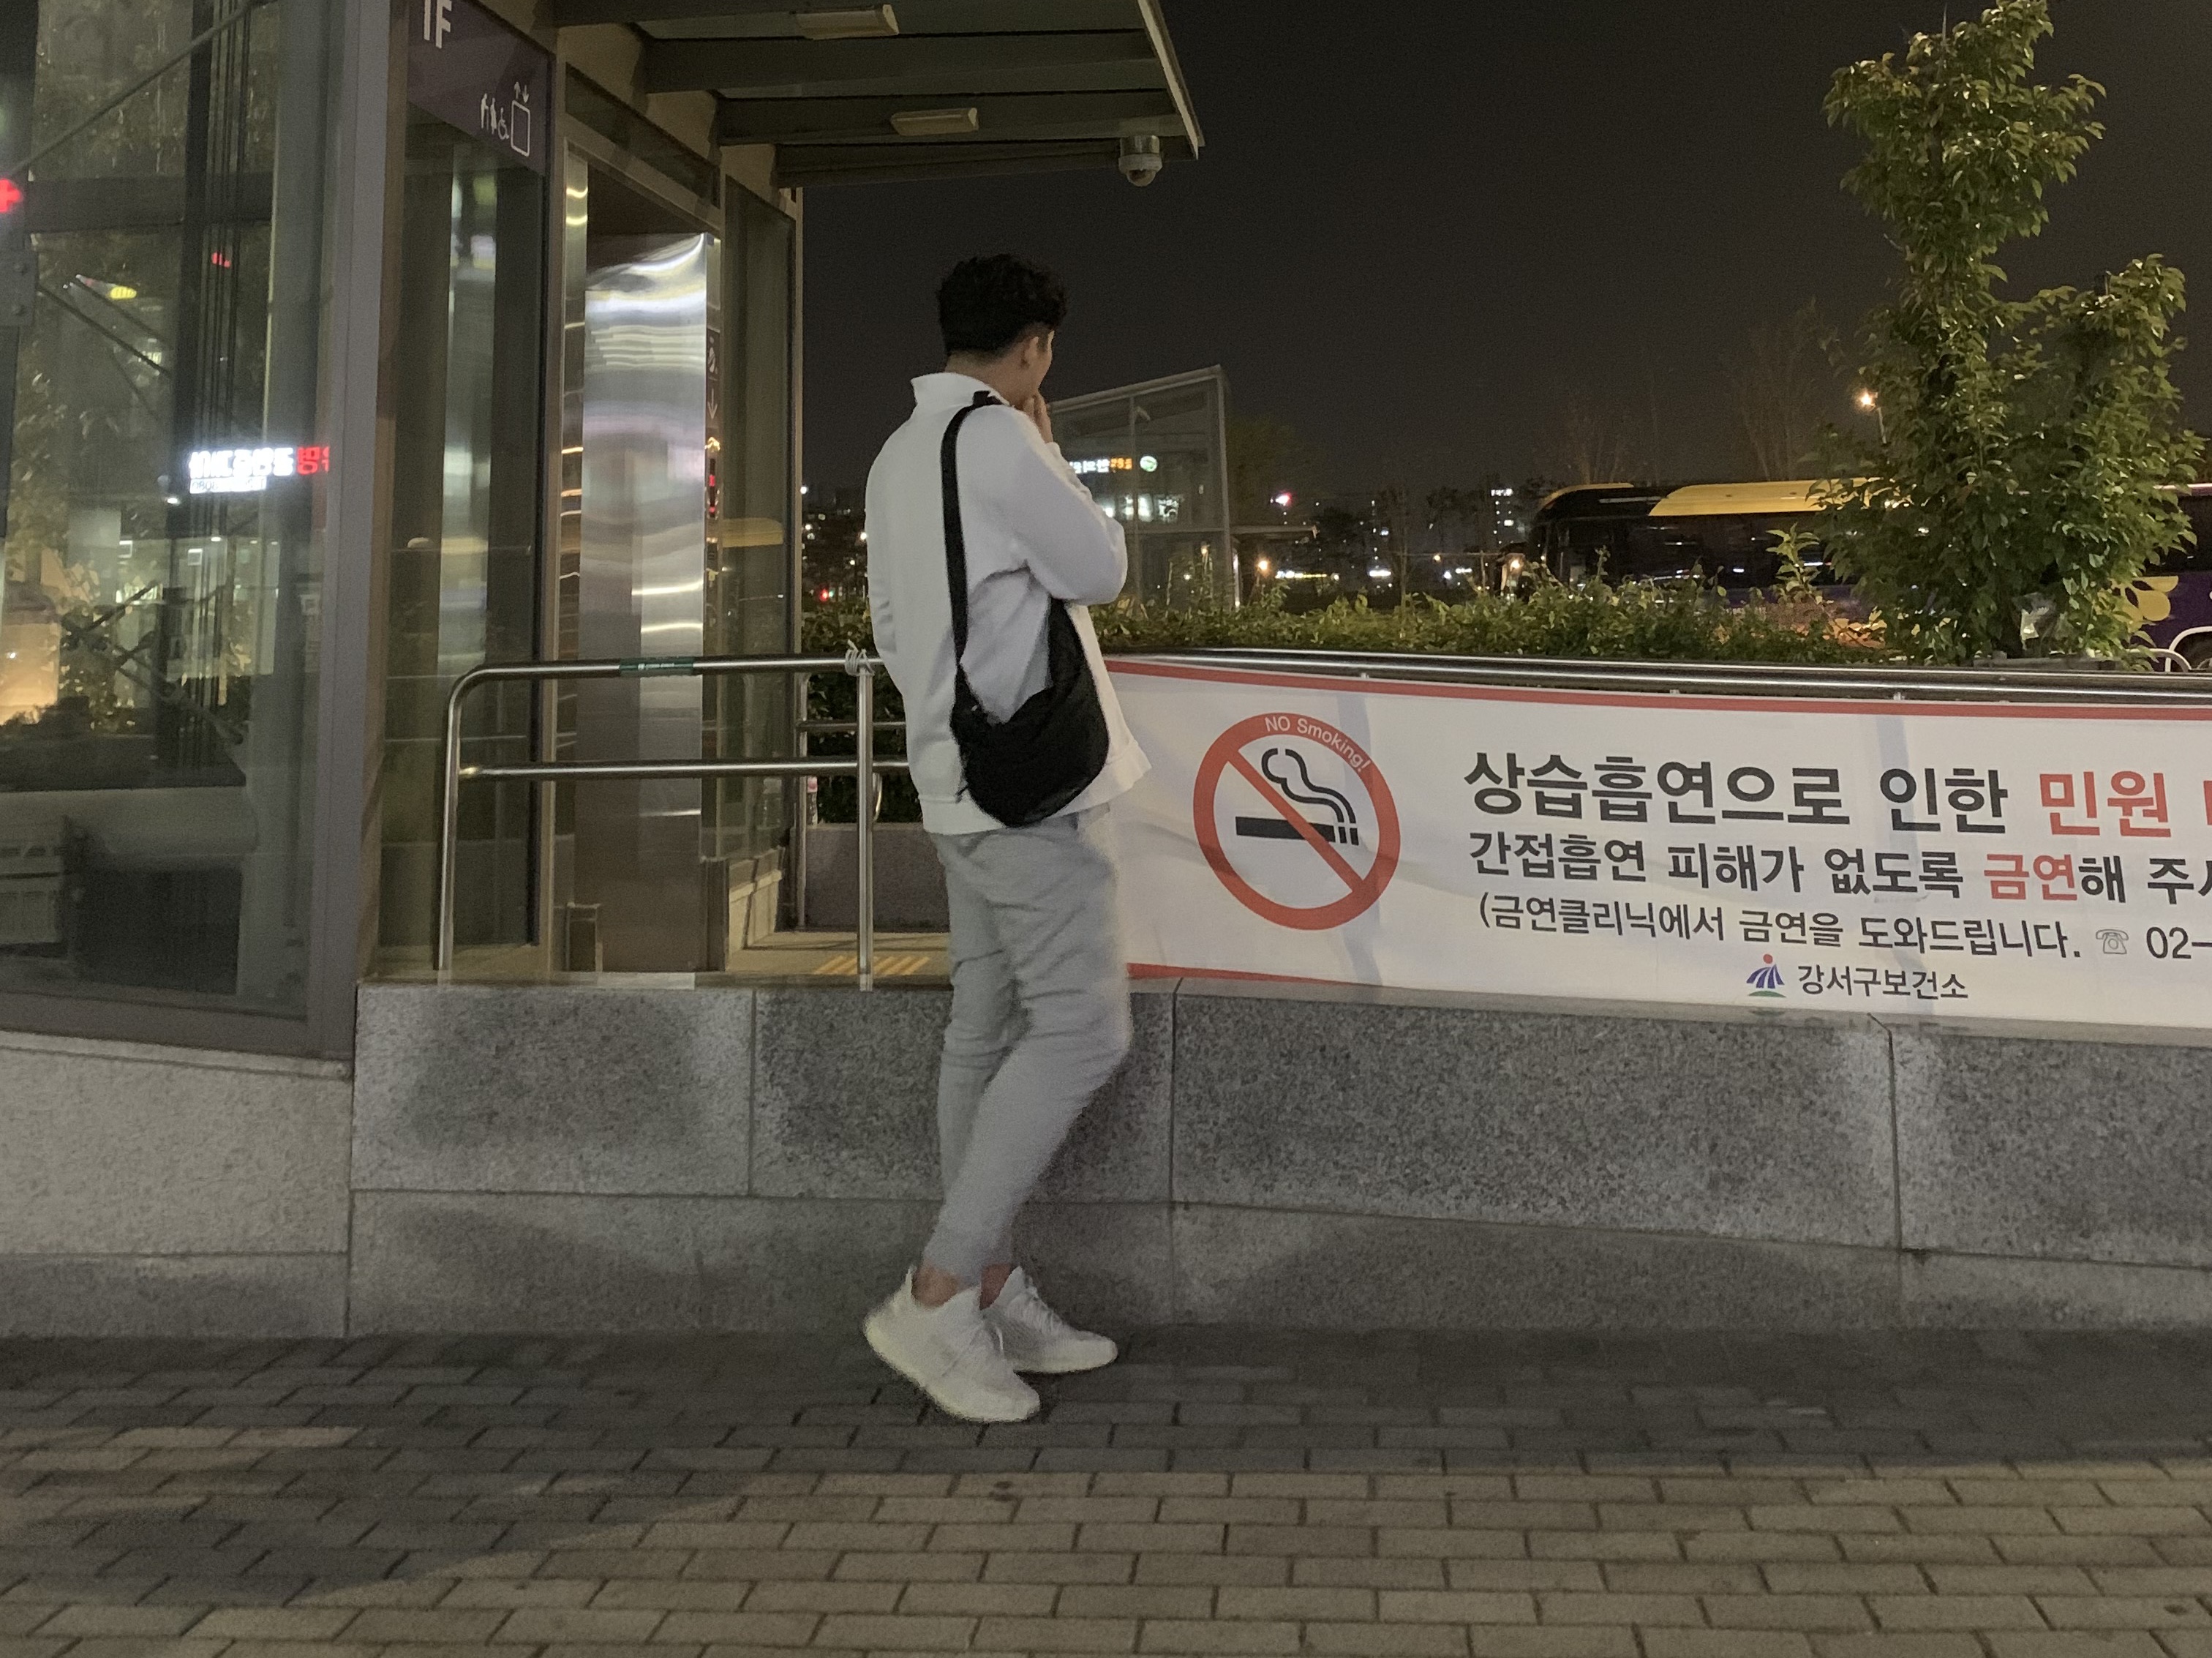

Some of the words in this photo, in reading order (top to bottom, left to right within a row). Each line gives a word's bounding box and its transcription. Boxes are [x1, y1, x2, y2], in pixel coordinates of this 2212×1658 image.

[1265, 716, 1291, 732] NO
[1297, 717, 1372, 773] Smoking!
[1464, 751, 1851, 828] 상습흡연으로
[1879, 768, 2009, 834] 인한
[2039, 770, 2172, 838] 민원
[1470, 830, 1647, 882] 간접흡연
[1667, 842, 1805, 893] 피해가
[1824, 848, 1964, 899] 없도록
[1983, 853, 2126, 904] 금연해
[1480, 891, 1724, 941] (금연클리닉에서
[1739, 909, 1844, 948] 금연을
[1859, 918, 2081, 959] 도와드립니다.
[1797, 964, 1968, 1000] 강서구보건소
